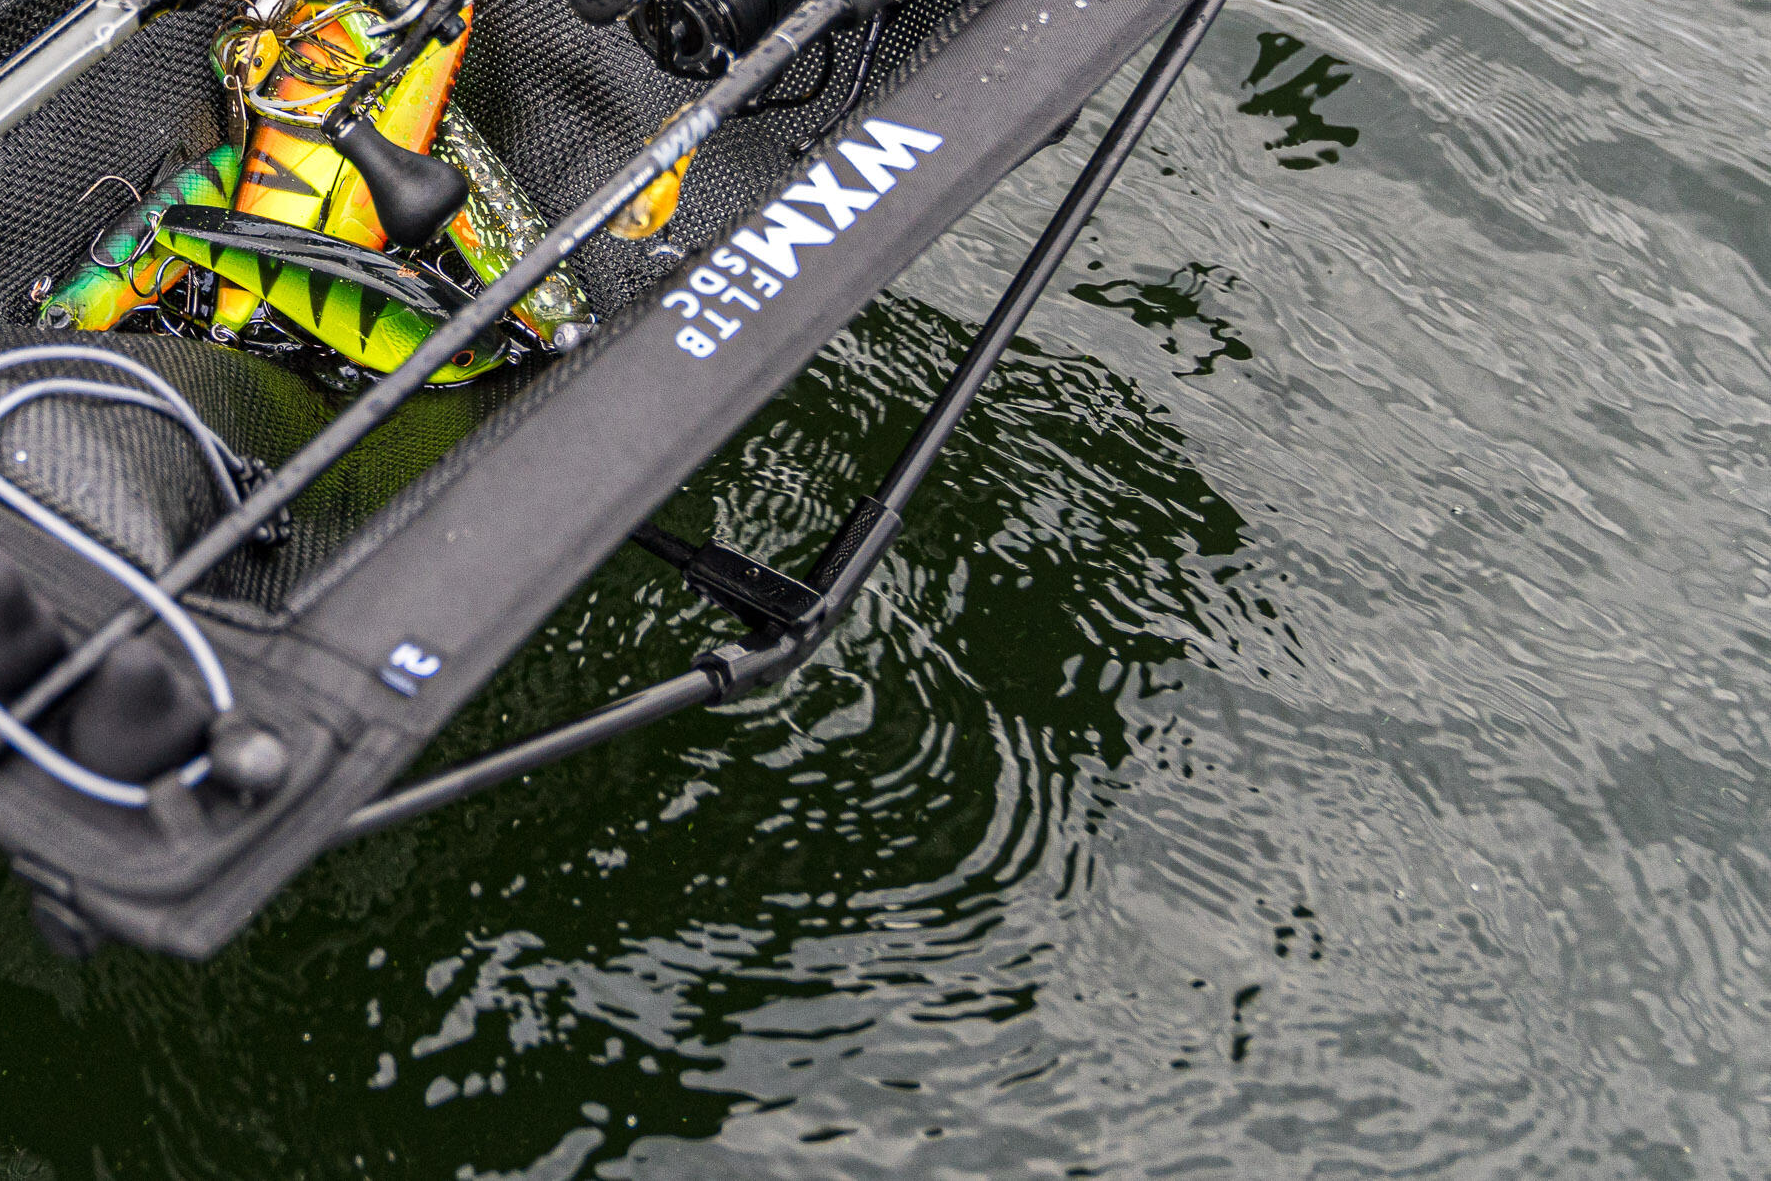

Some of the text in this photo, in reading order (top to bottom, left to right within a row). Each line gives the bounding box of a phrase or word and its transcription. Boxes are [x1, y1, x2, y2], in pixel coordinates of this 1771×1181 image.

[652, 107, 718, 170] WXM
[731, 118, 944, 279] WXM
[662, 247, 748, 319] SDC
[676, 267, 784, 359] FLTB
